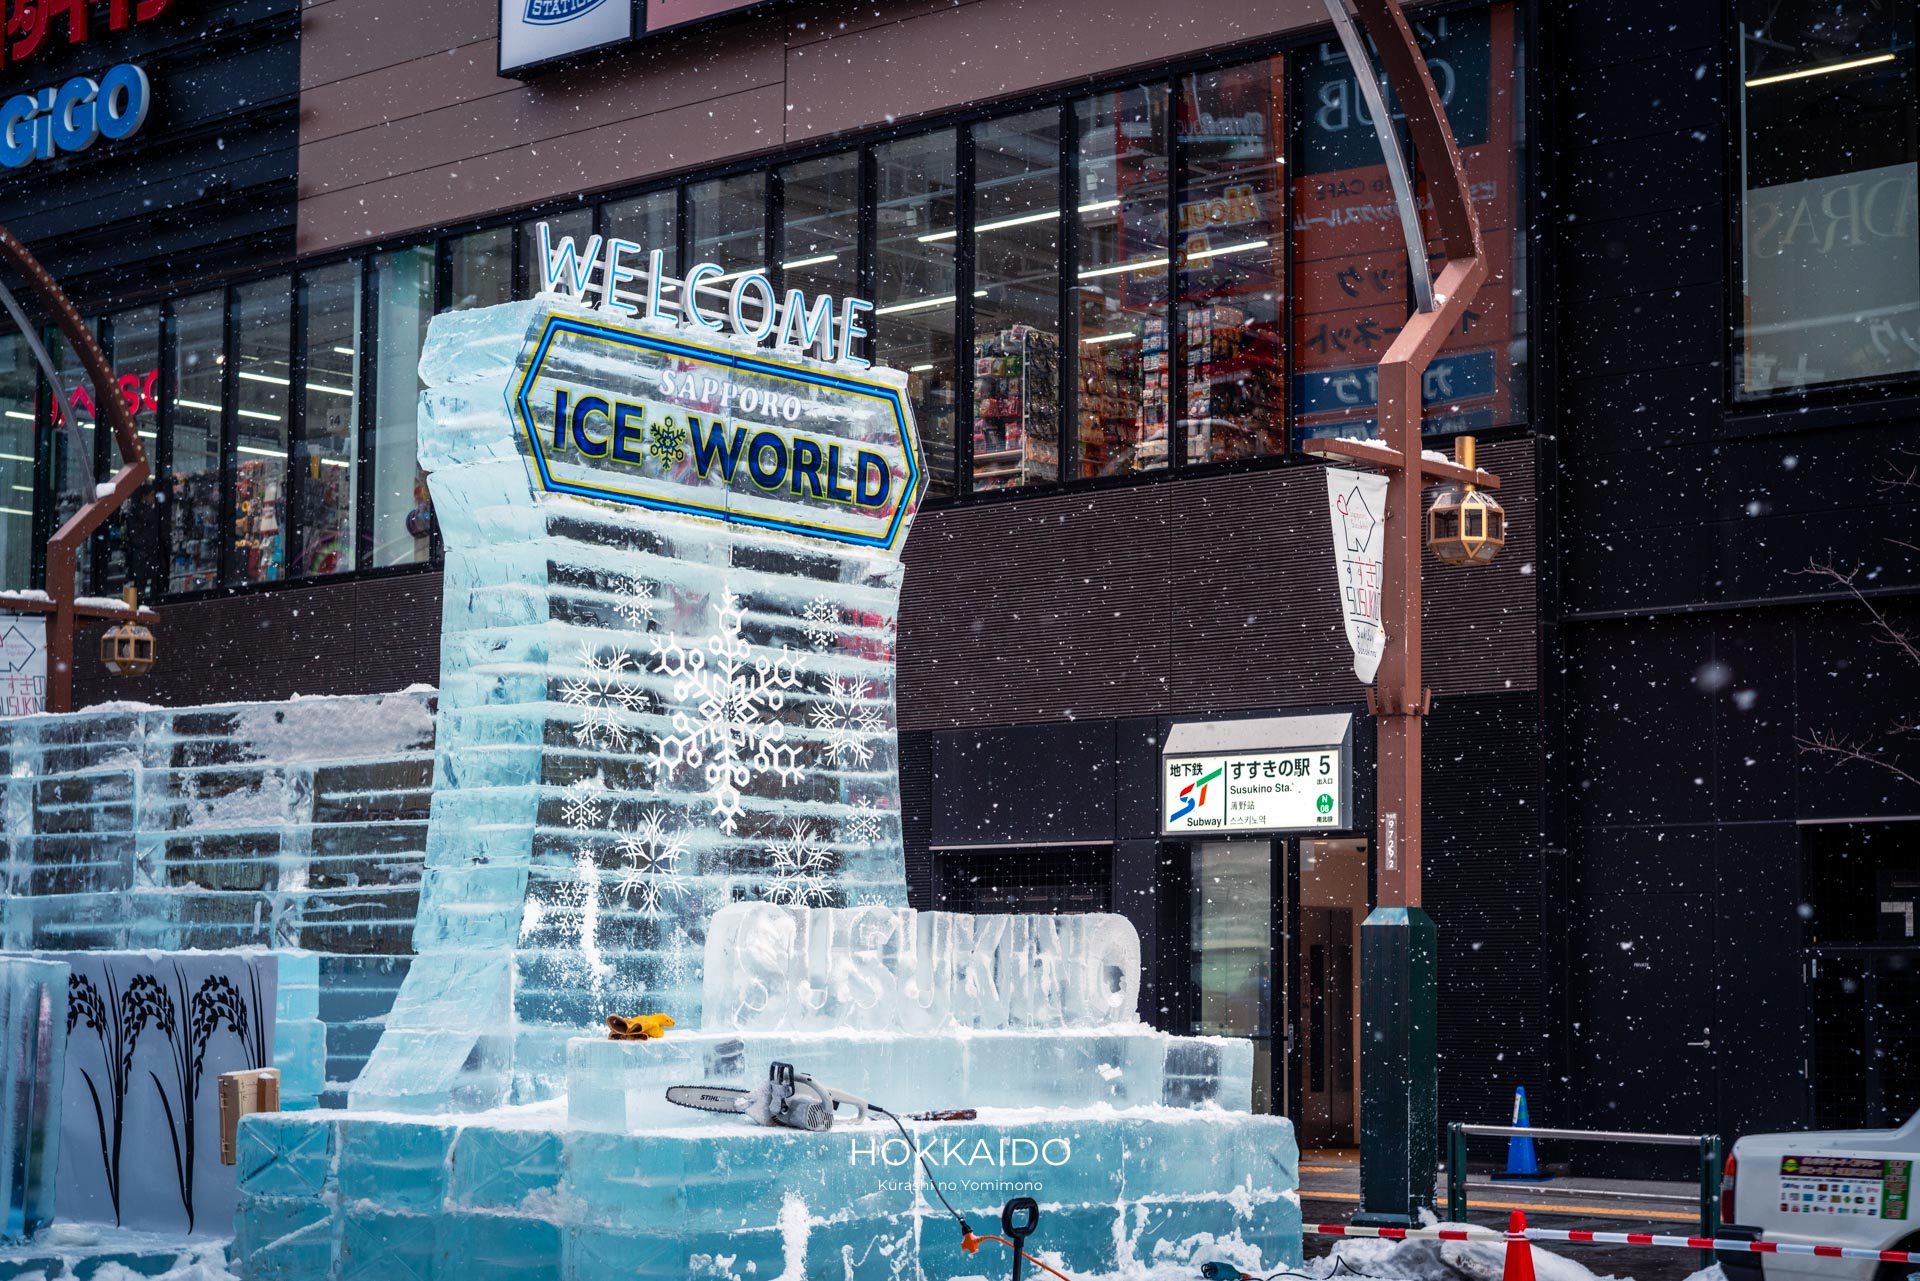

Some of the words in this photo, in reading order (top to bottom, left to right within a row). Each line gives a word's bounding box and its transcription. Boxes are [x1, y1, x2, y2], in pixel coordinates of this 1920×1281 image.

[536, 221, 875, 369] WELCOME
[658, 369, 804, 422] SAPPORO
[552, 387, 646, 467] ICE
[687, 415, 892, 509] WORLD
[1170, 763, 1203, 777] 地下鉄
[1230, 758, 1310, 780] すすきの駅
[1319, 755, 1331, 775] 5
[1230, 784, 1273, 795] Susukino
[1275, 783, 1293, 793] Sta.
[1321, 795, 1328, 803] N
[1187, 817, 1222, 828] Subway
[700, 1094, 720, 1102] STIHL
